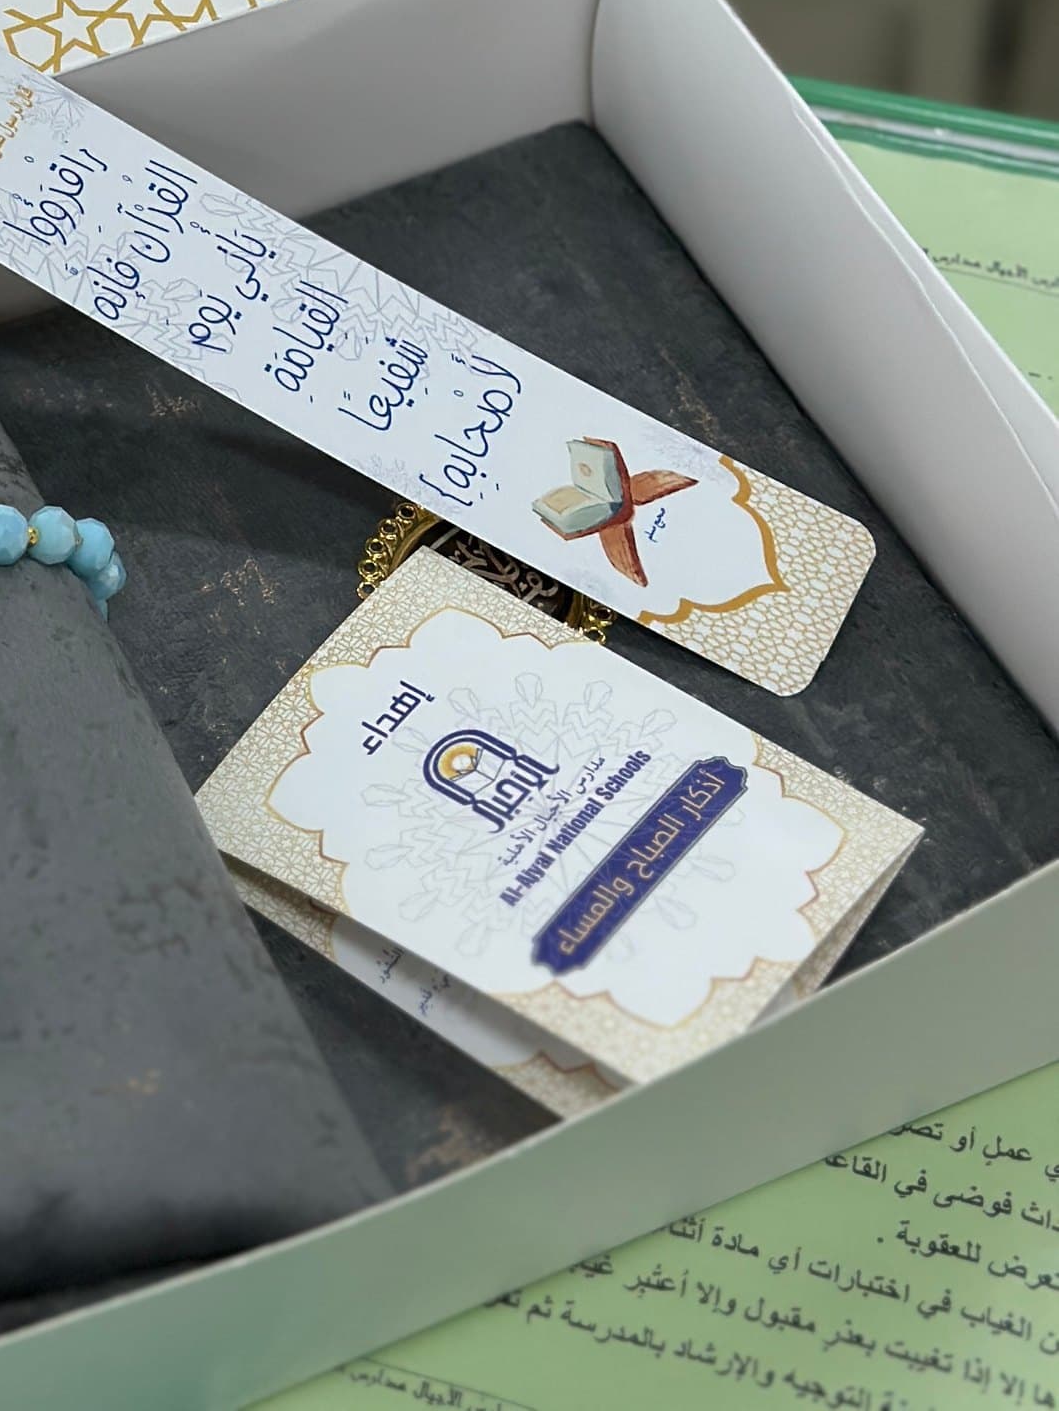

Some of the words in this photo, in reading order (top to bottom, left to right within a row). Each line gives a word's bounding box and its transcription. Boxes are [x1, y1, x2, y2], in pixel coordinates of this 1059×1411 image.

[361, 680, 436, 756] إهداء
[576, 757, 606, 795] مدارس
[679, 768, 726, 821] أذكار
[499, 851, 556, 907] Al-Ajyal
[545, 797, 606, 855] National
[594, 750, 652, 801] Schools
[533, 789, 573, 832] الأجيال
[498, 828, 538, 867] الأهلية
[626, 813, 686, 879] الصباح
[558, 876, 635, 956] والمساء
[949, 1126, 976, 1152] أو
[824, 1155, 888, 1183] القاع
[894, 1169, 929, 1198] في
[933, 1186, 1013, 1217] فوضى
[711, 1226, 760, 1257] مادة
[768, 1246, 802, 1274] أي
[895, 1219, 982, 1264] للعقوبة
[696, 1281, 737, 1317] وإلا
[807, 1260, 911, 1303] اختبارات
[743, 1297, 816, 1333] مقبول
[916, 1289, 952, 1319] في
[560, 1299, 666, 1359] بالمدرسة
[960, 1306, 1032, 1341] الغياب
[673, 1339, 775, 1387] والإرشاد
